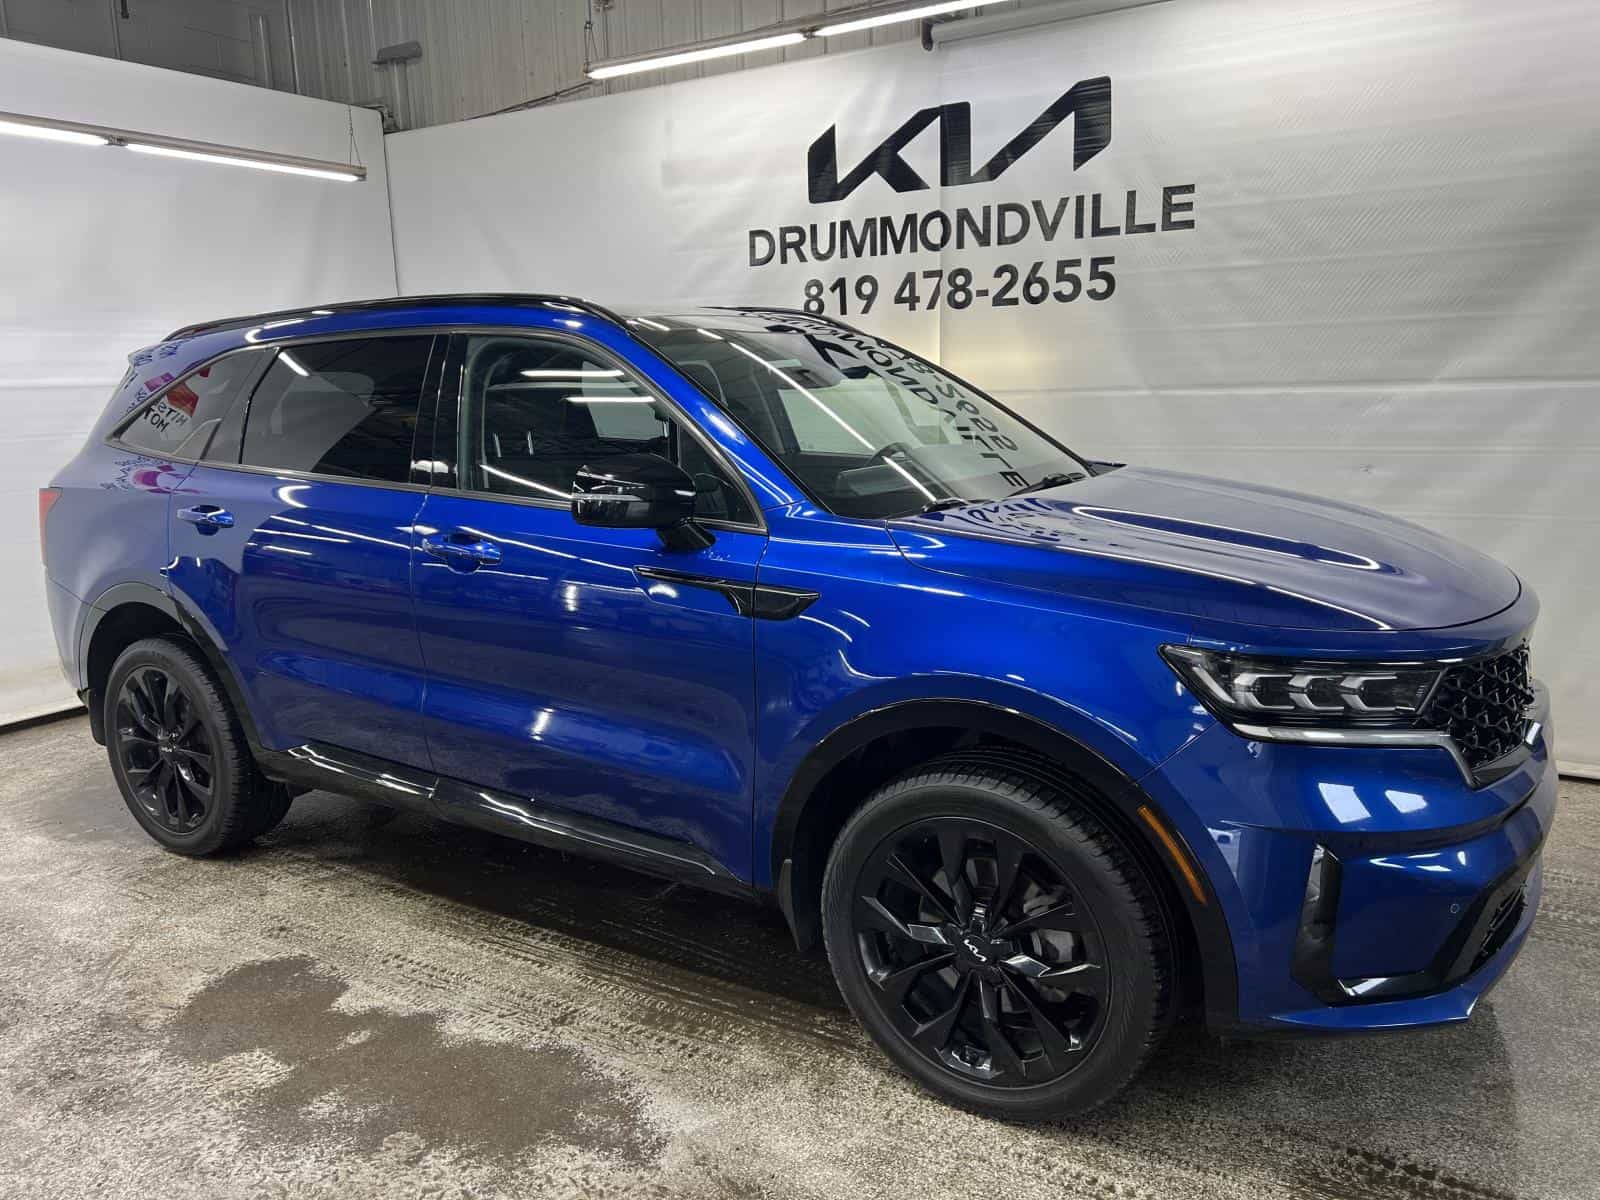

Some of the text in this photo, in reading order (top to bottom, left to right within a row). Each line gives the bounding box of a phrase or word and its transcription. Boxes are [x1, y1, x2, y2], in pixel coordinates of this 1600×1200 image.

[807, 75, 1112, 204] KIA
[748, 183, 1197, 268] DRUMMONDVILLE
[803, 256, 1117, 317] 819 478-2655
